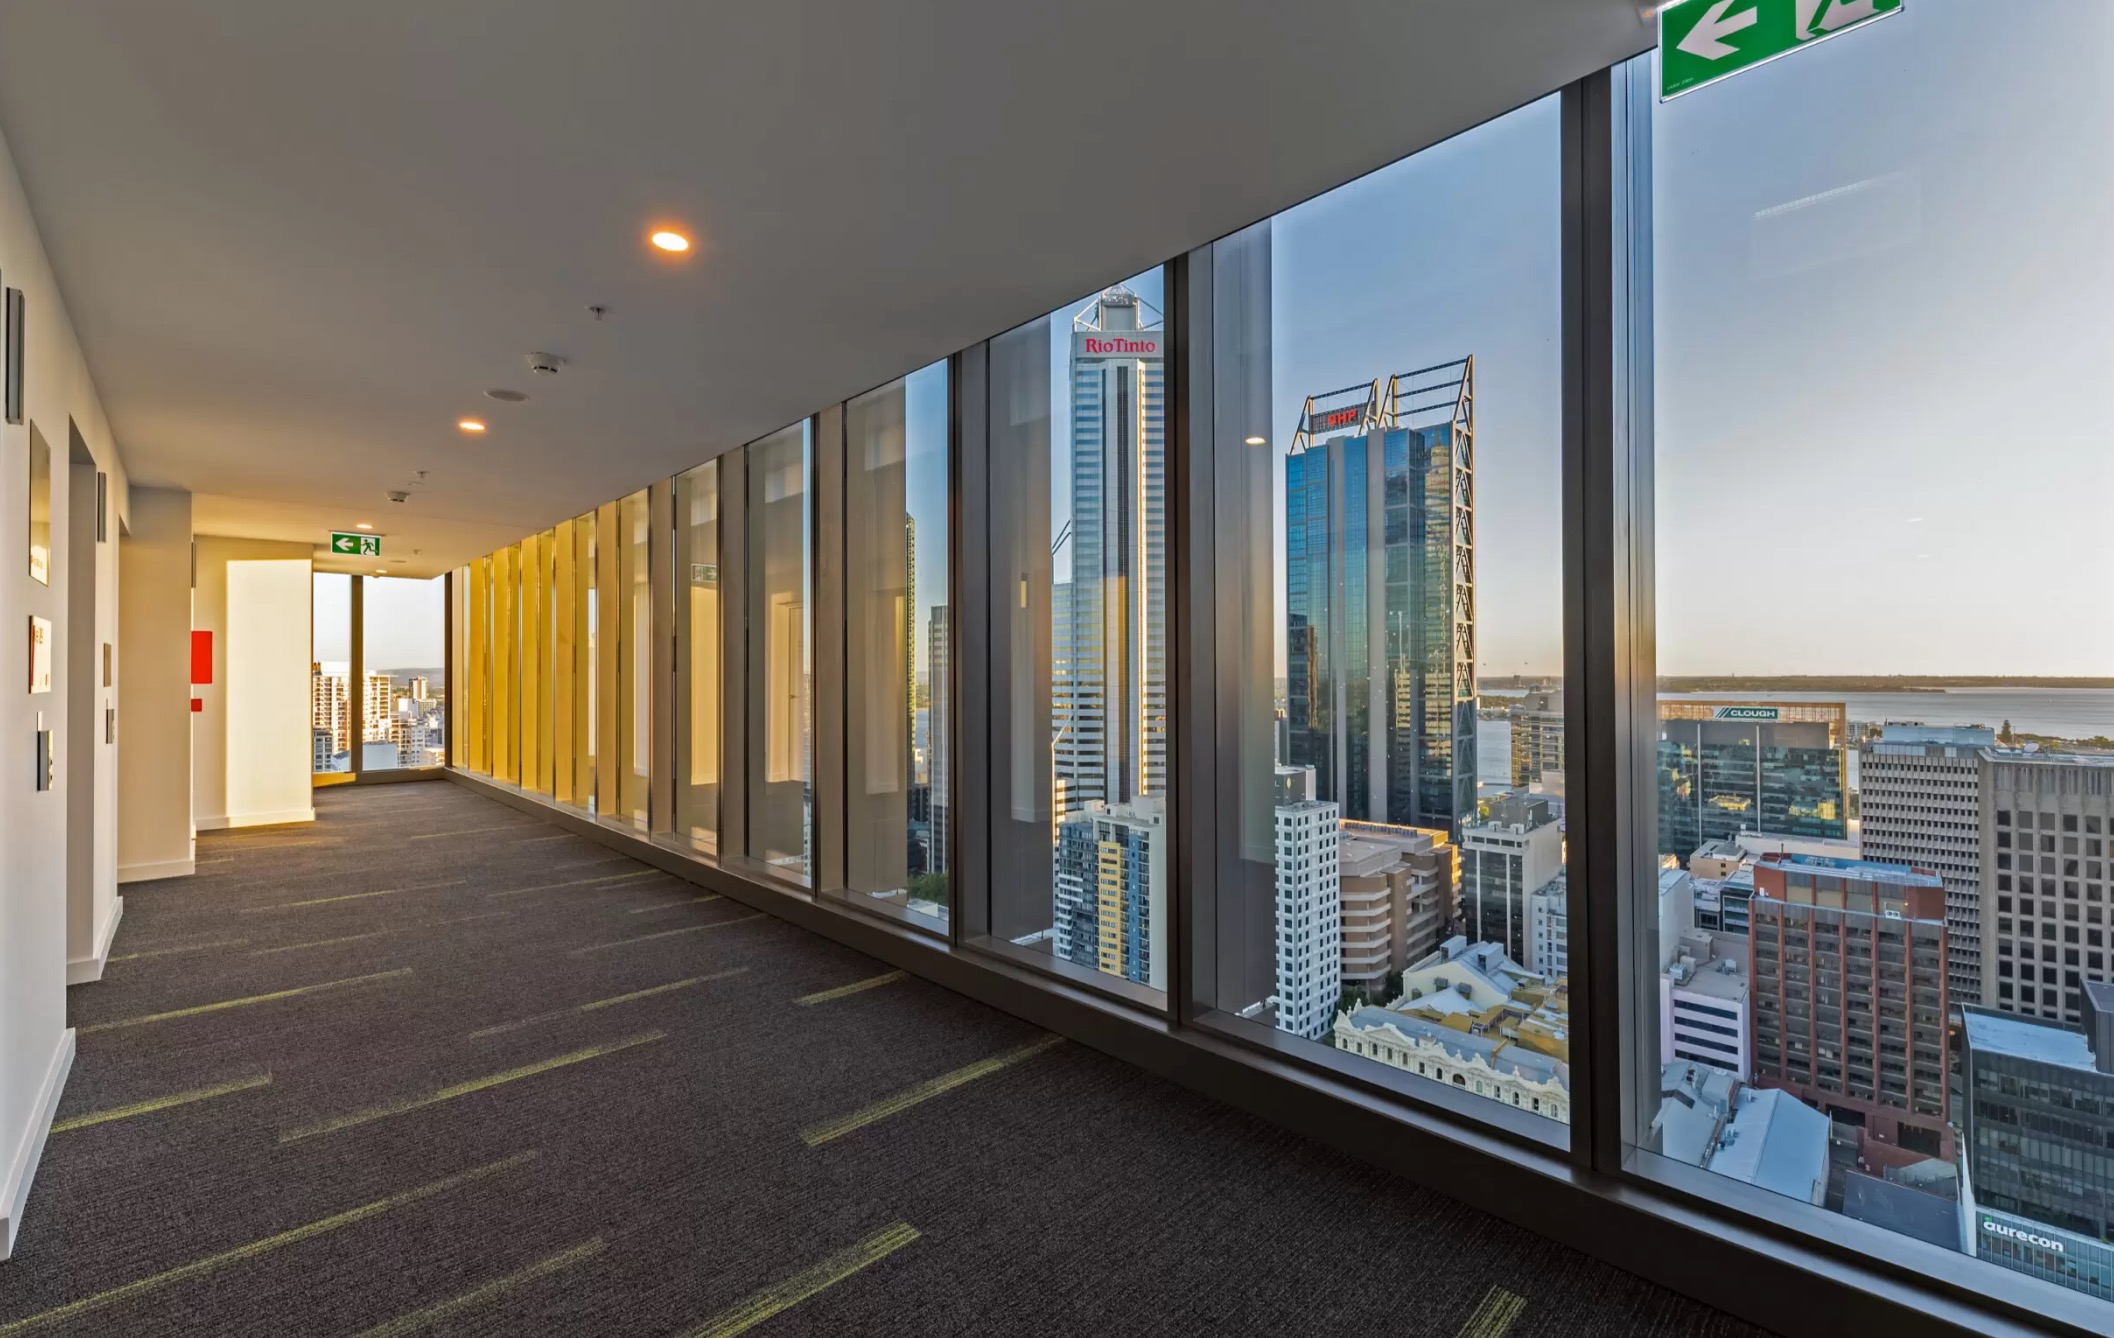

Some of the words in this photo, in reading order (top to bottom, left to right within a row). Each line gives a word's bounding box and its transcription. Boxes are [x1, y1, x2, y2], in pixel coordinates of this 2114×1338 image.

[1327, 408, 1357, 427] BHP
[1730, 709, 1775, 717] CLOUGH
[1983, 1221, 2064, 1252] aurecon
